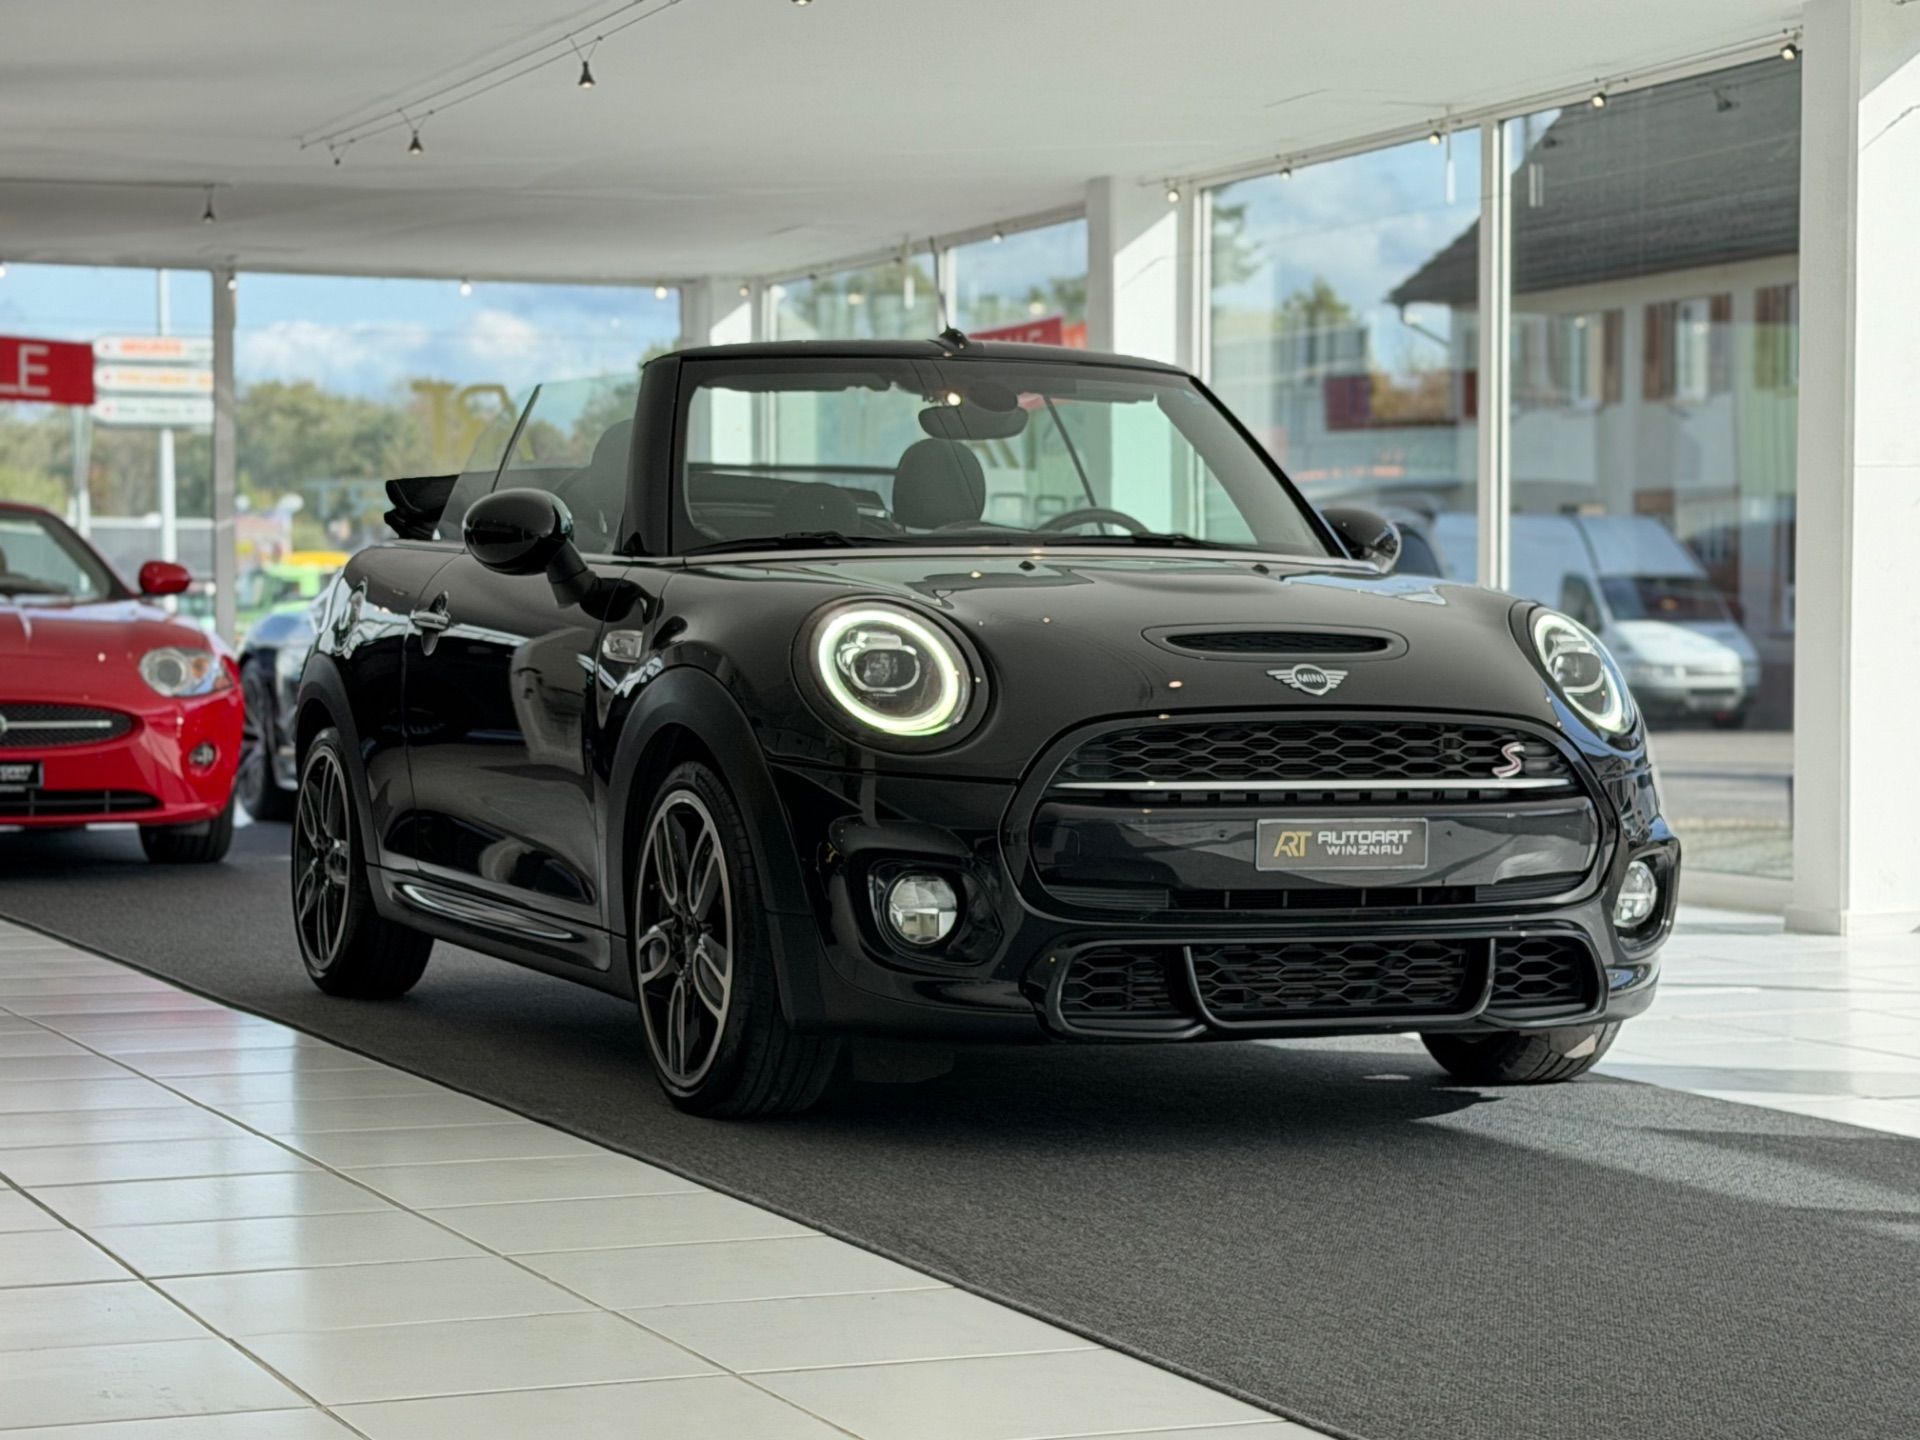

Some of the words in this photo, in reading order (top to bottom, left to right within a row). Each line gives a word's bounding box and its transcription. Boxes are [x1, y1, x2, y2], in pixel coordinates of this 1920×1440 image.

[0, 343, 50, 396] E
[1296, 673, 1326, 684] MINI
[1317, 830, 1413, 845] AUTOART
[1325, 845, 1404, 856] WINZNAU
